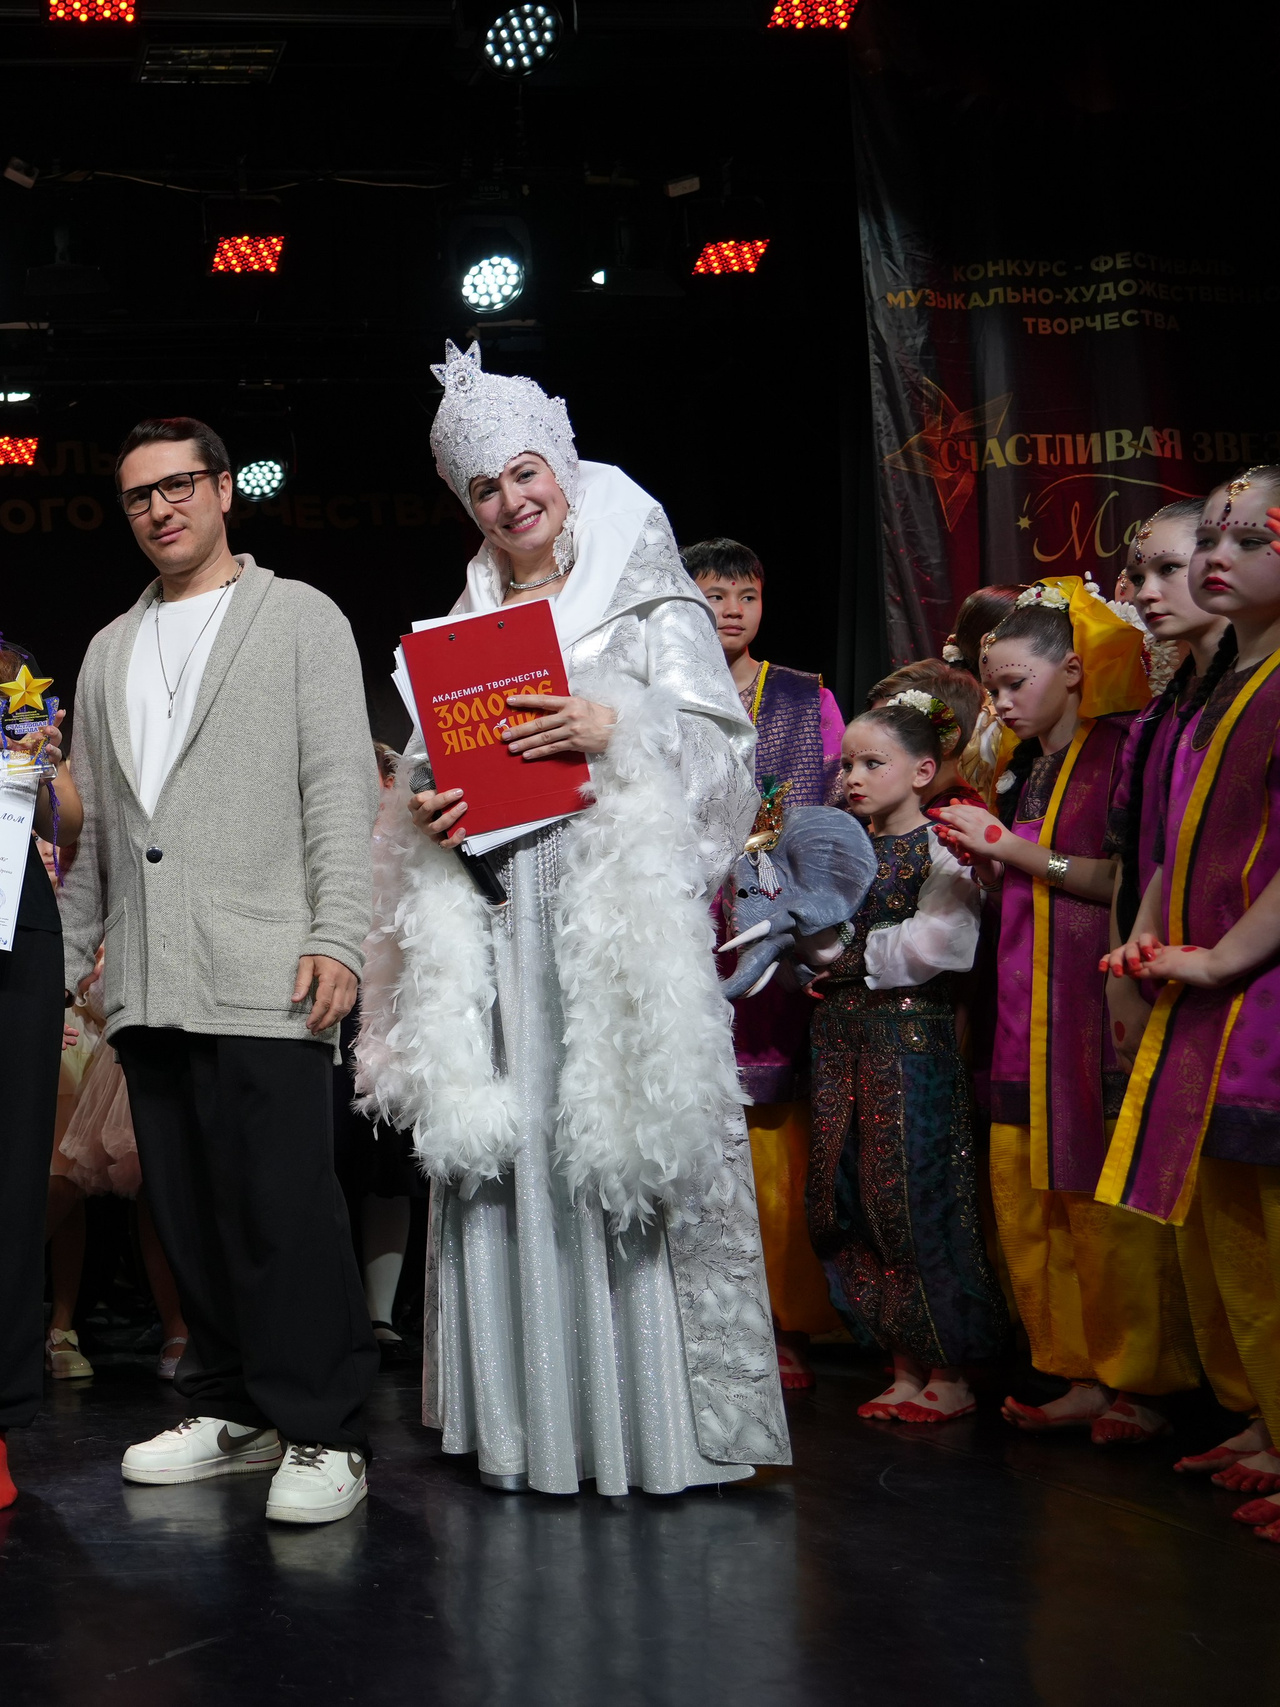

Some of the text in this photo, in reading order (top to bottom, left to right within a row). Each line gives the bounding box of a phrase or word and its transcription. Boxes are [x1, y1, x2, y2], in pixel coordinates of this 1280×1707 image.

[952, 259, 1068, 282] КОНКУРС
[1089, 250, 1236, 275] ФЕСТИВАЛЬ
[1022, 308, 1180, 336] ТВОРЧЕСТВА
[939, 425, 1182, 473] СЧАСТЛИВАЯ
[432, 669, 549, 704] АКАДЕМИЯ ТВОРЧЕСТВА
